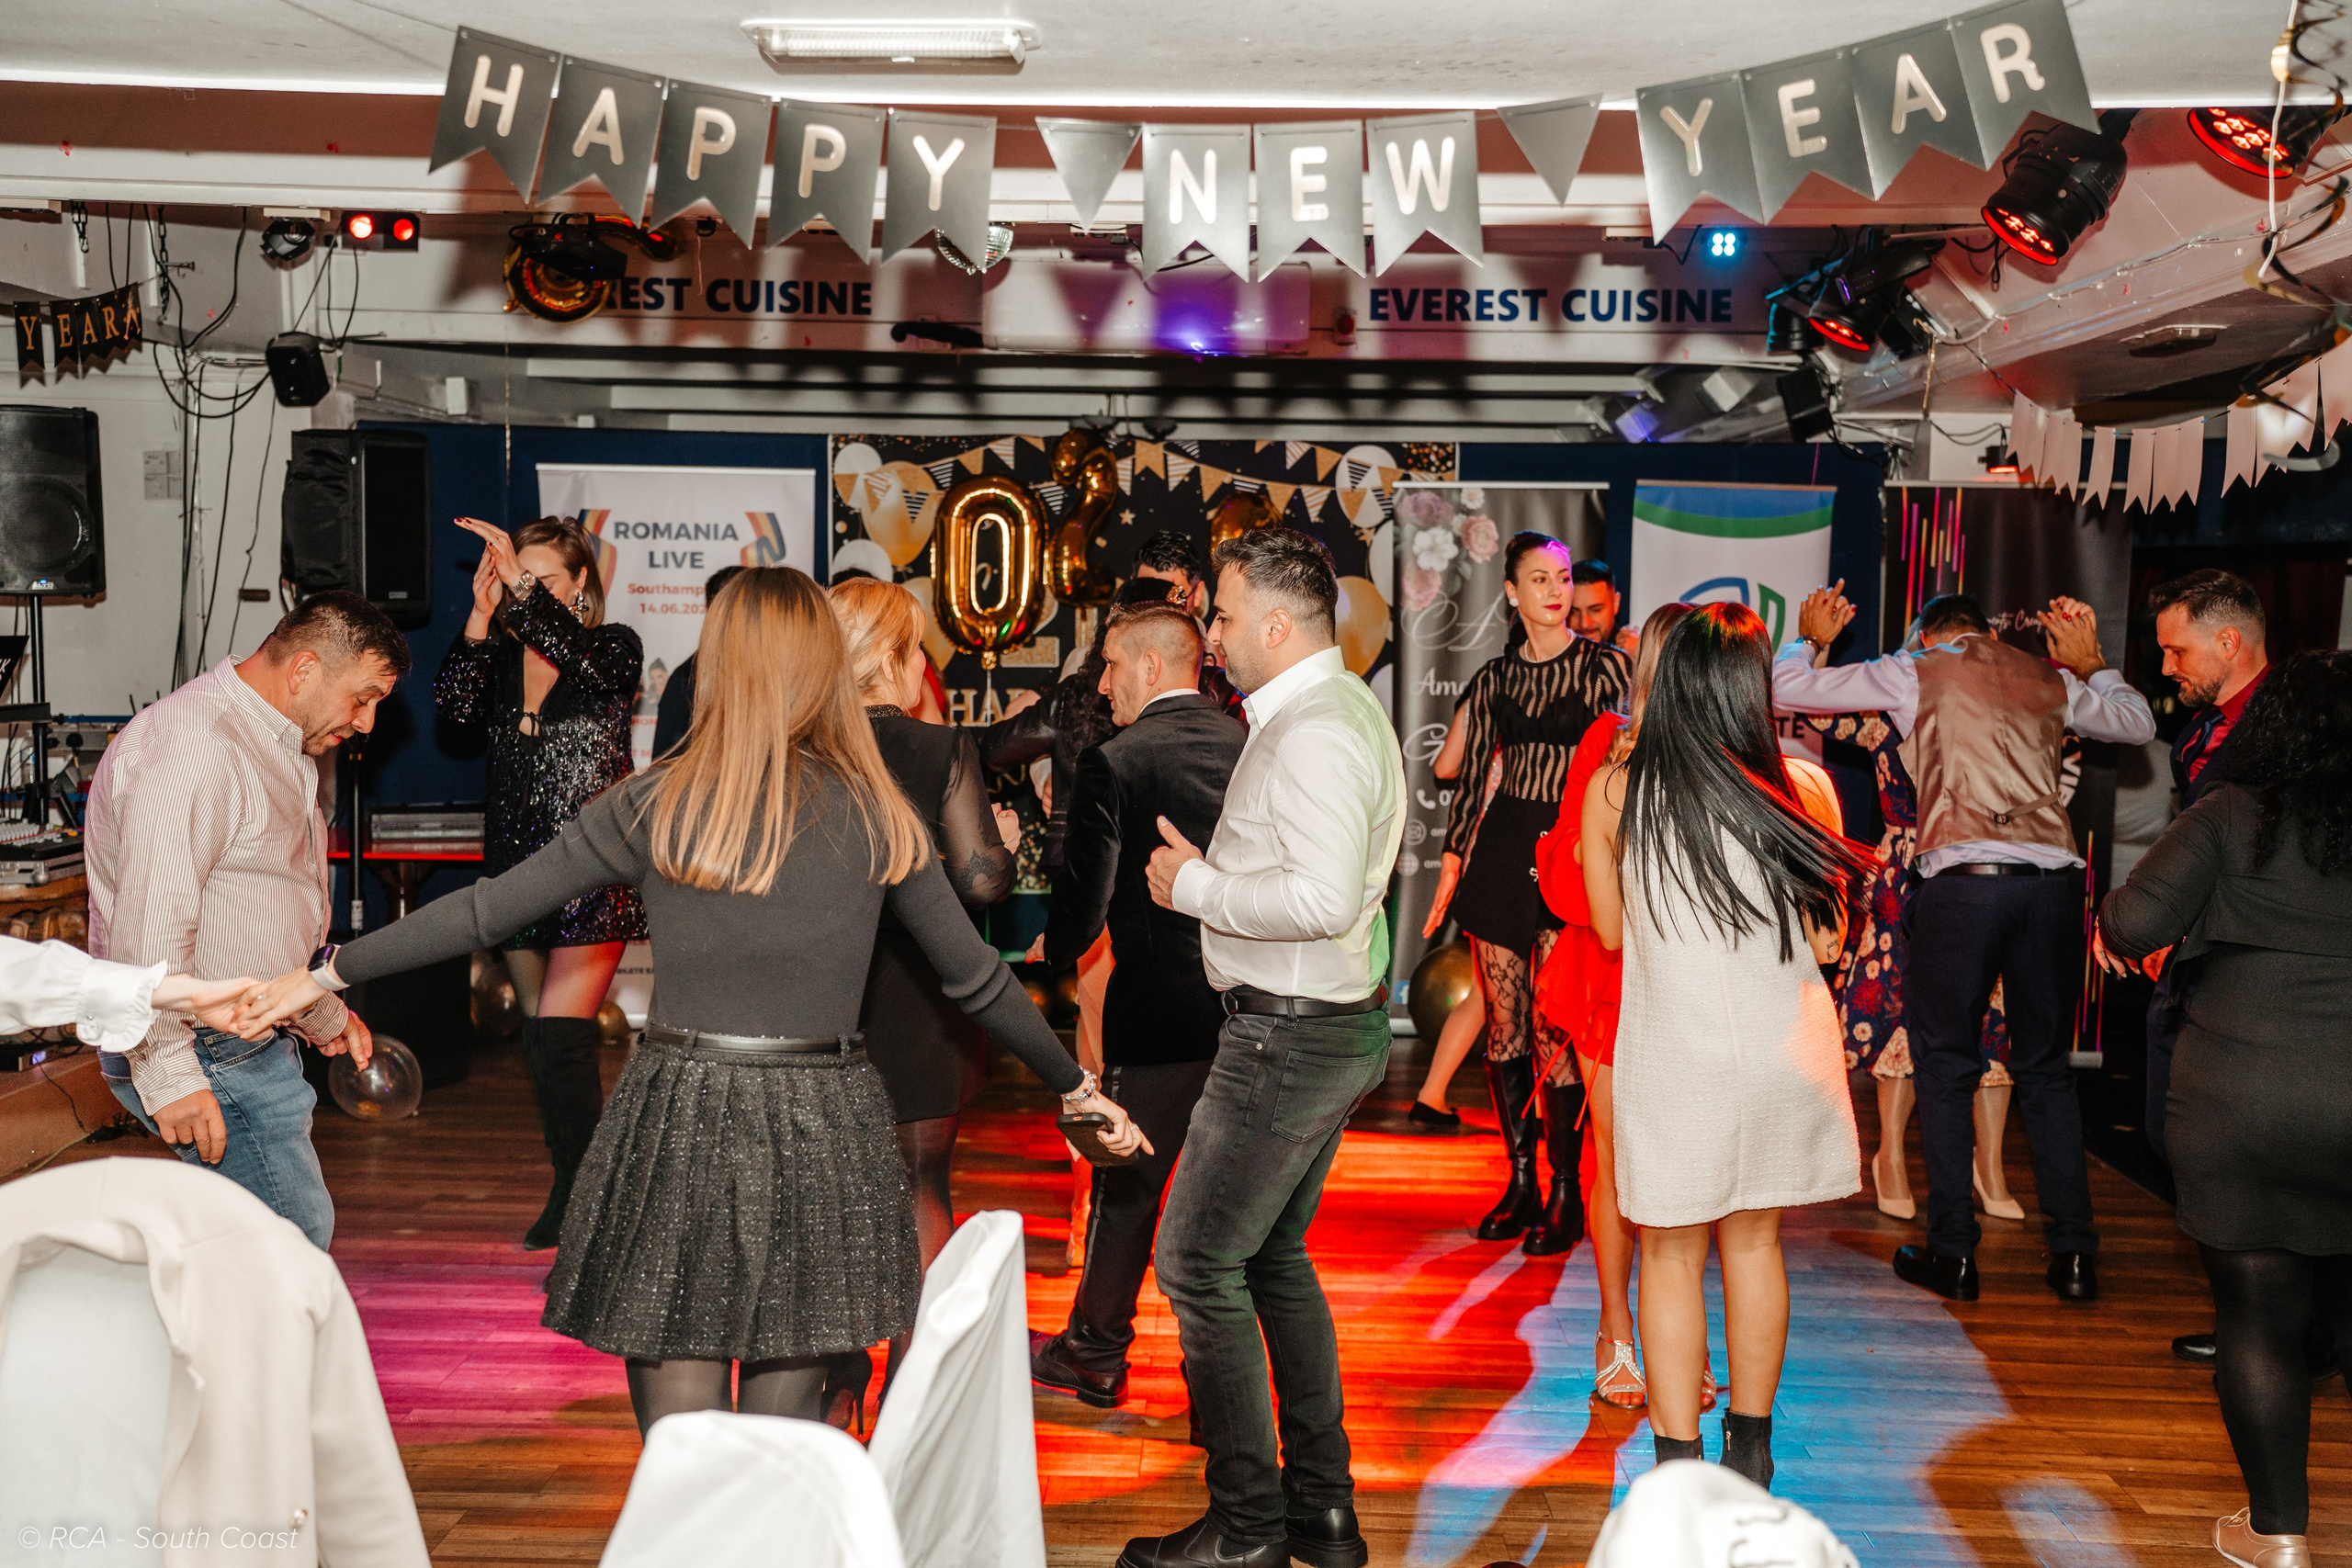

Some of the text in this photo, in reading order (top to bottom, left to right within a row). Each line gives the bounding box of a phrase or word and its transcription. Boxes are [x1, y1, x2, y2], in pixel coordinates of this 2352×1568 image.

[464, 22, 2046, 224] HAPPY NEW YEAR
[706, 279, 871, 315] CUISINE
[1370, 288, 1733, 323] EVEREST CUISINE
[19, 306, 120, 350] YEAR
[614, 522, 740, 541] ROMANIA
[649, 551, 705, 569] LIVE
[628, 582, 707, 597] Southamp
